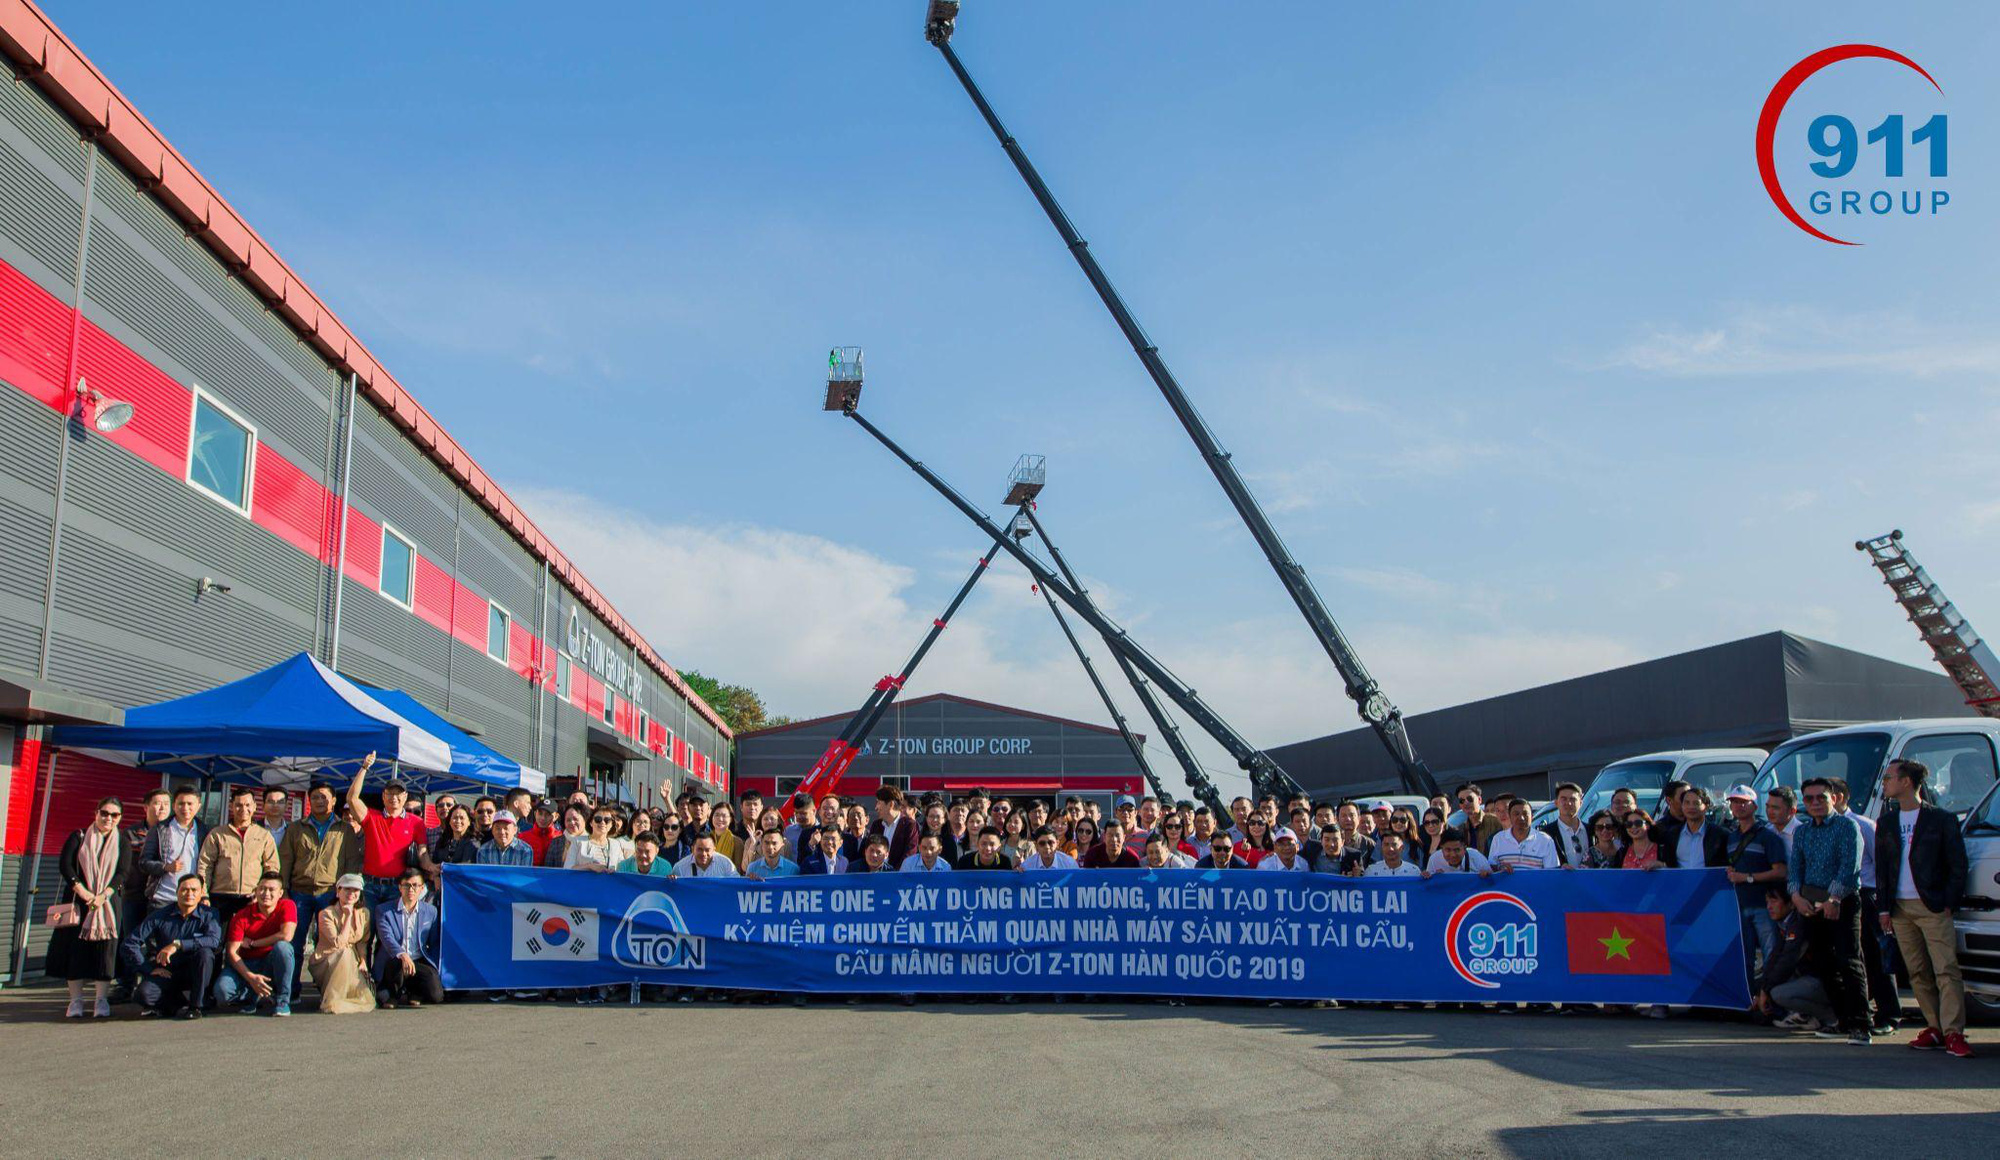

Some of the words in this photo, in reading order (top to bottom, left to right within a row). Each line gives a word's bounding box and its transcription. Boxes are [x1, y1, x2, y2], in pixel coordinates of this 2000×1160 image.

[581, 627, 605, 677] Z-TON
[605, 646, 627, 692] GROUP
[878, 738, 927, 755] Z-TON
[931, 738, 985, 755] GROUP
[989, 738, 1033, 755] CORP.
[737, 891, 773, 913] WE
[779, 890, 823, 913] ARE
[830, 889, 875, 913] ONE
[898, 884, 939, 912] XÂY
[946, 886, 1013, 915] DỰNG
[1020, 882, 1069, 909] NỀN
[1077, 882, 1150, 912] MÓNG,
[1157, 882, 1214, 910] KIẾN
[1221, 888, 1267, 915] TẠO
[1274, 888, 1364, 913] TƯƠNG
[1371, 890, 1408, 914] LAI
[724, 919, 756, 942] KỶ
[763, 918, 825, 947] NIỆM
[832, 917, 925, 944] CHUYẾN
[931, 914, 997, 943] THĂM
[1005, 919, 1066, 945] QUAN
[1073, 915, 1120, 942] NHÀ
[1126, 915, 1174, 943] MÁY
[1181, 915, 1232, 945] SẢN
[1238, 917, 1302, 946] XUẤT
[1307, 918, 1348, 947] TẢI
[1355, 919, 1414, 952] CẨU,
[1468, 923, 1538, 957] 911
[632, 934, 705, 969] TON
[835, 948, 884, 976] CẨU
[891, 948, 953, 975] NÂNG
[961, 948, 1041, 975] NGƯỜI
[1048, 952, 1114, 976] Z-TON
[1121, 949, 1168, 977] HÀN
[1175, 950, 1242, 980] QUỐC
[1249, 956, 1305, 981] 2019
[1469, 958, 1538, 975] GROUP
